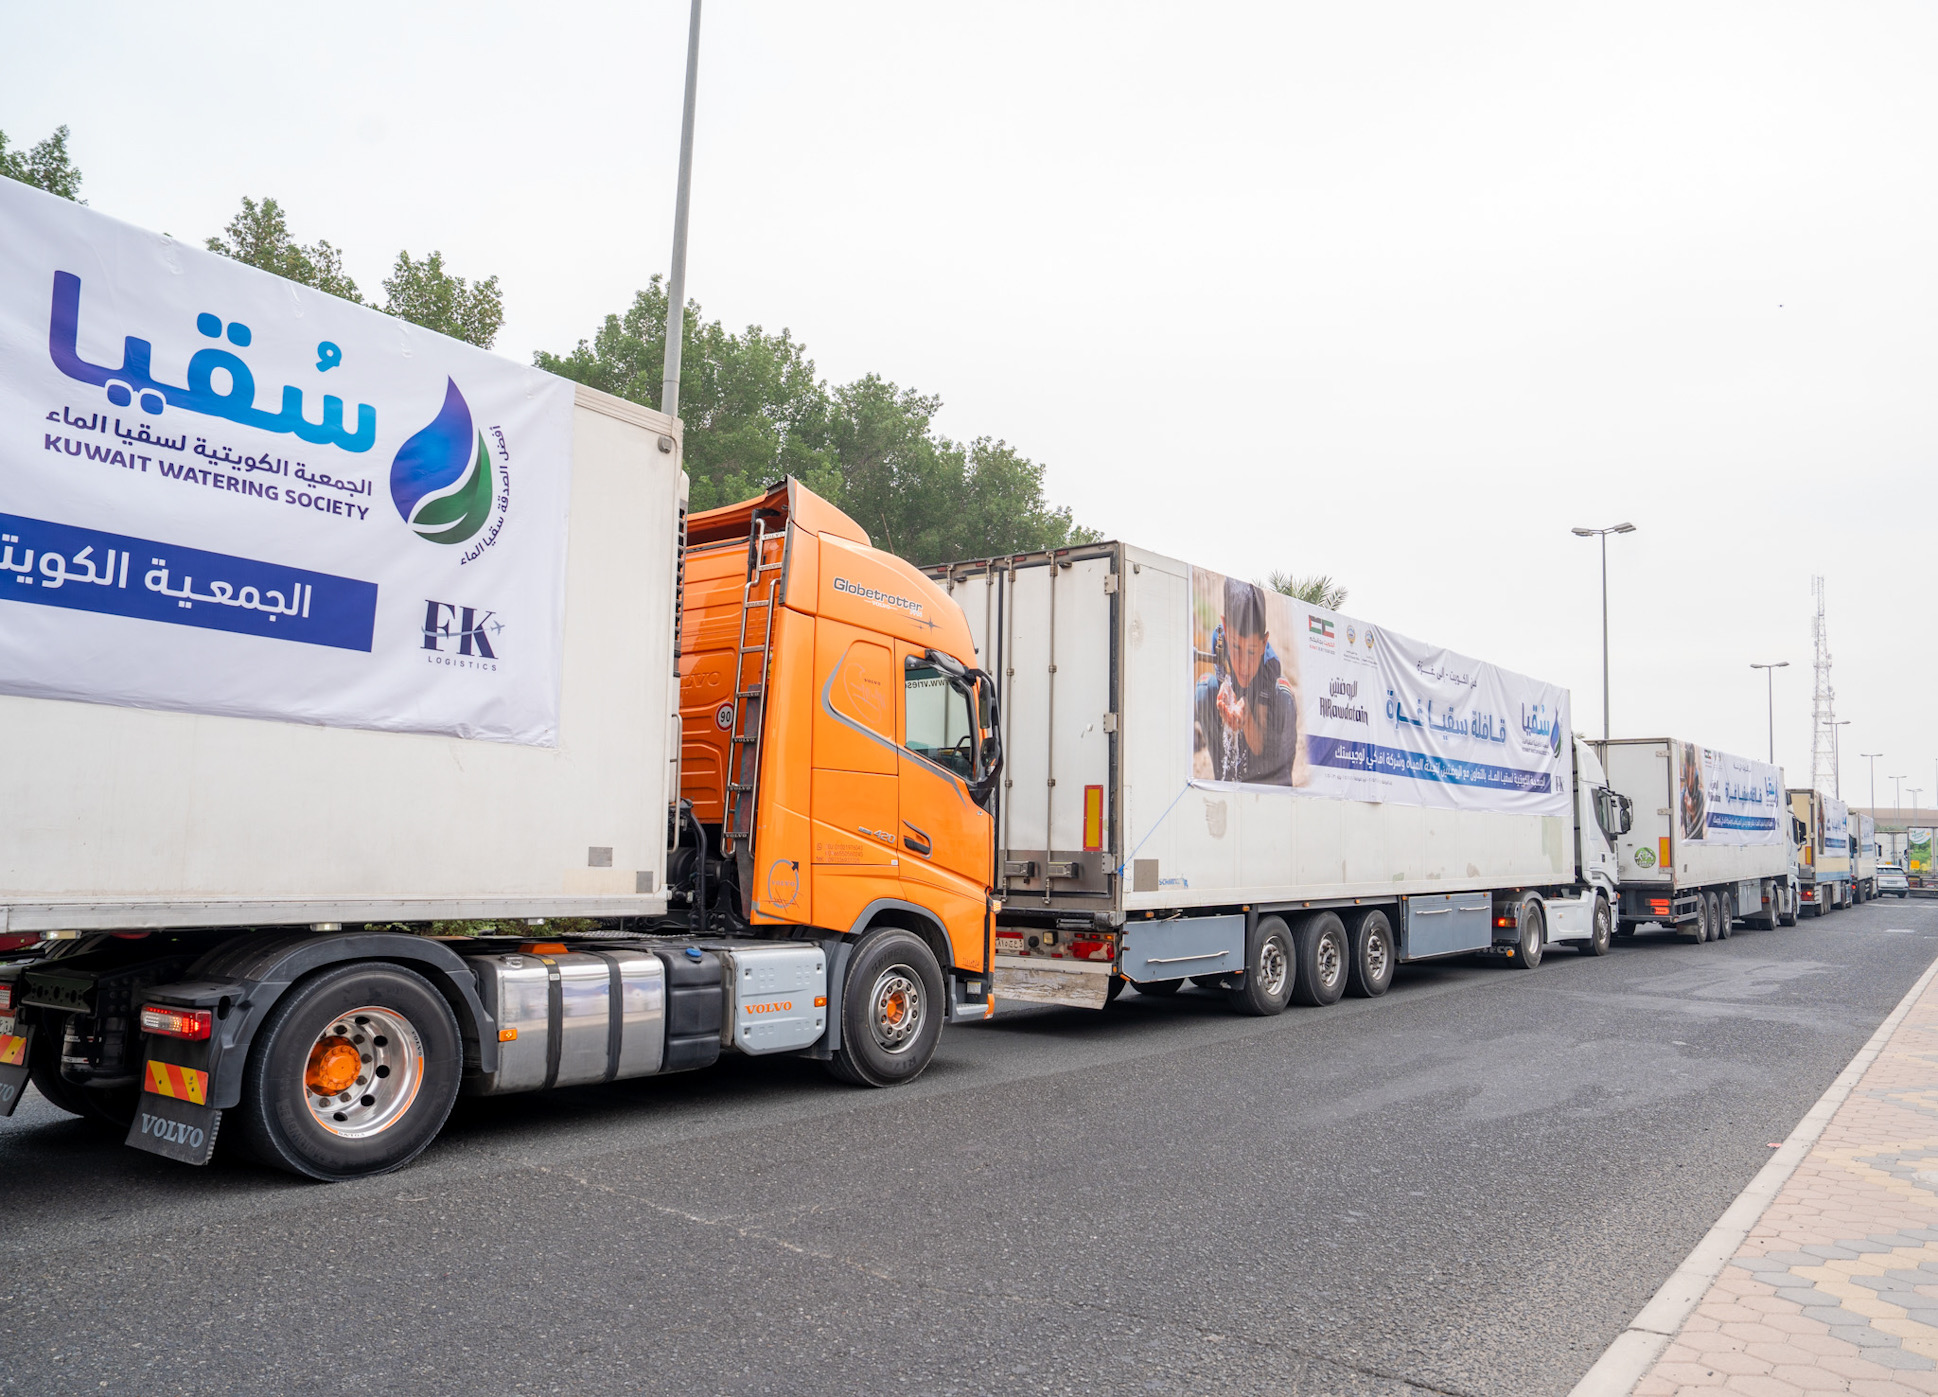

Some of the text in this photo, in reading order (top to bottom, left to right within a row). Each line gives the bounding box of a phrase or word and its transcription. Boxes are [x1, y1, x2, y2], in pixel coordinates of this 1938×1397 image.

[46, 406, 373, 497] الجمعية الكويتية لسقيا الماء
[44, 433, 369, 520] KUWAIT WATERING SOCIETY
[460, 425, 510, 566] أفضل الصدقة سقيا الماء
[0, 533, 312, 622] الجمعية الكويت
[834, 577, 922, 611] Globetrotter
[420, 599, 499, 660] FK
[428, 656, 498, 671] LOGISTICS
[680, 671, 721, 688] LVO
[1450, 673, 1470, 687] الكويت
[720, 711, 731, 723] 90
[873, 829, 896, 844] 420
[744, 1001, 792, 1014] VOLVO
[411, 1030, 422, 1056] VOLVO
[141, 1113, 204, 1147] VOLVO
